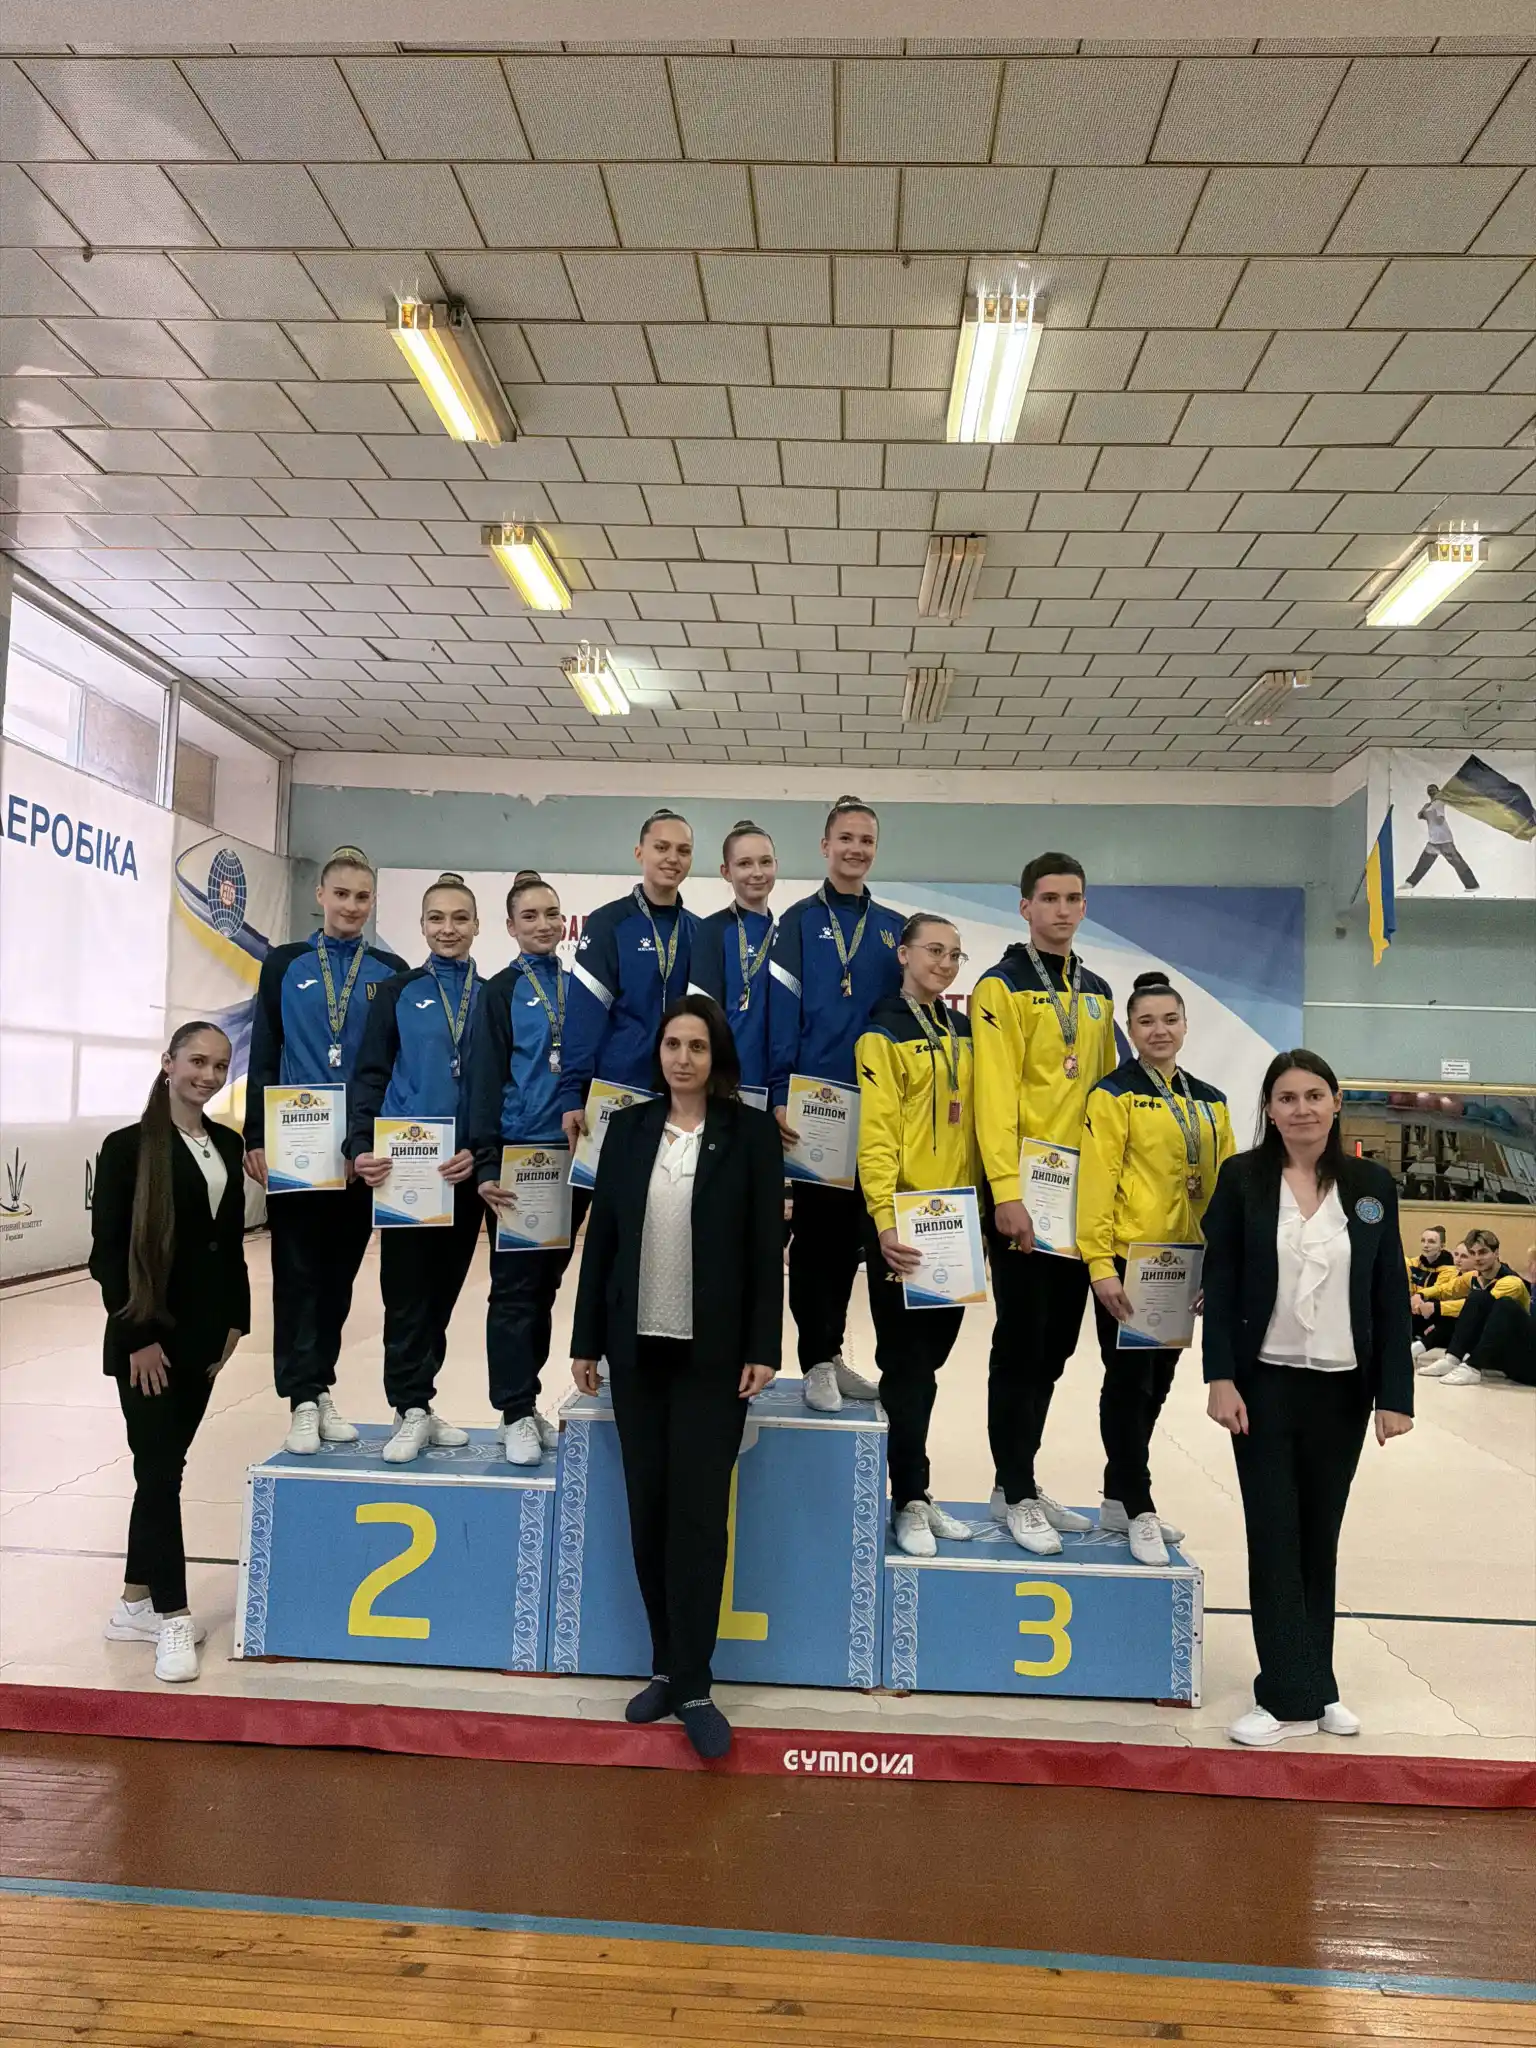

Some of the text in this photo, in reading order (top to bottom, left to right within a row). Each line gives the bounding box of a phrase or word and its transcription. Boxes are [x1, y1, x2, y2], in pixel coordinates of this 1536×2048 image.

[0, 794, 138, 881] ЕРОБІКА
[282, 1112, 330, 1124] ДИПЛОМ
[803, 1104, 846, 1121] ДИПЛОМ
[391, 1146, 438, 1157] ДИПЛОМ
[516, 1170, 559, 1182] ДИПЛОМ
[1031, 1169, 1070, 1186] ДИПЛОМ
[914, 1219, 963, 1234] ДИПЛОМ
[1141, 1270, 1187, 1281] ДИПЛОМ
[347, 1501, 437, 1640] 2
[1014, 1581, 1073, 1677] 3
[783, 1749, 914, 1775] GYMNOVA
